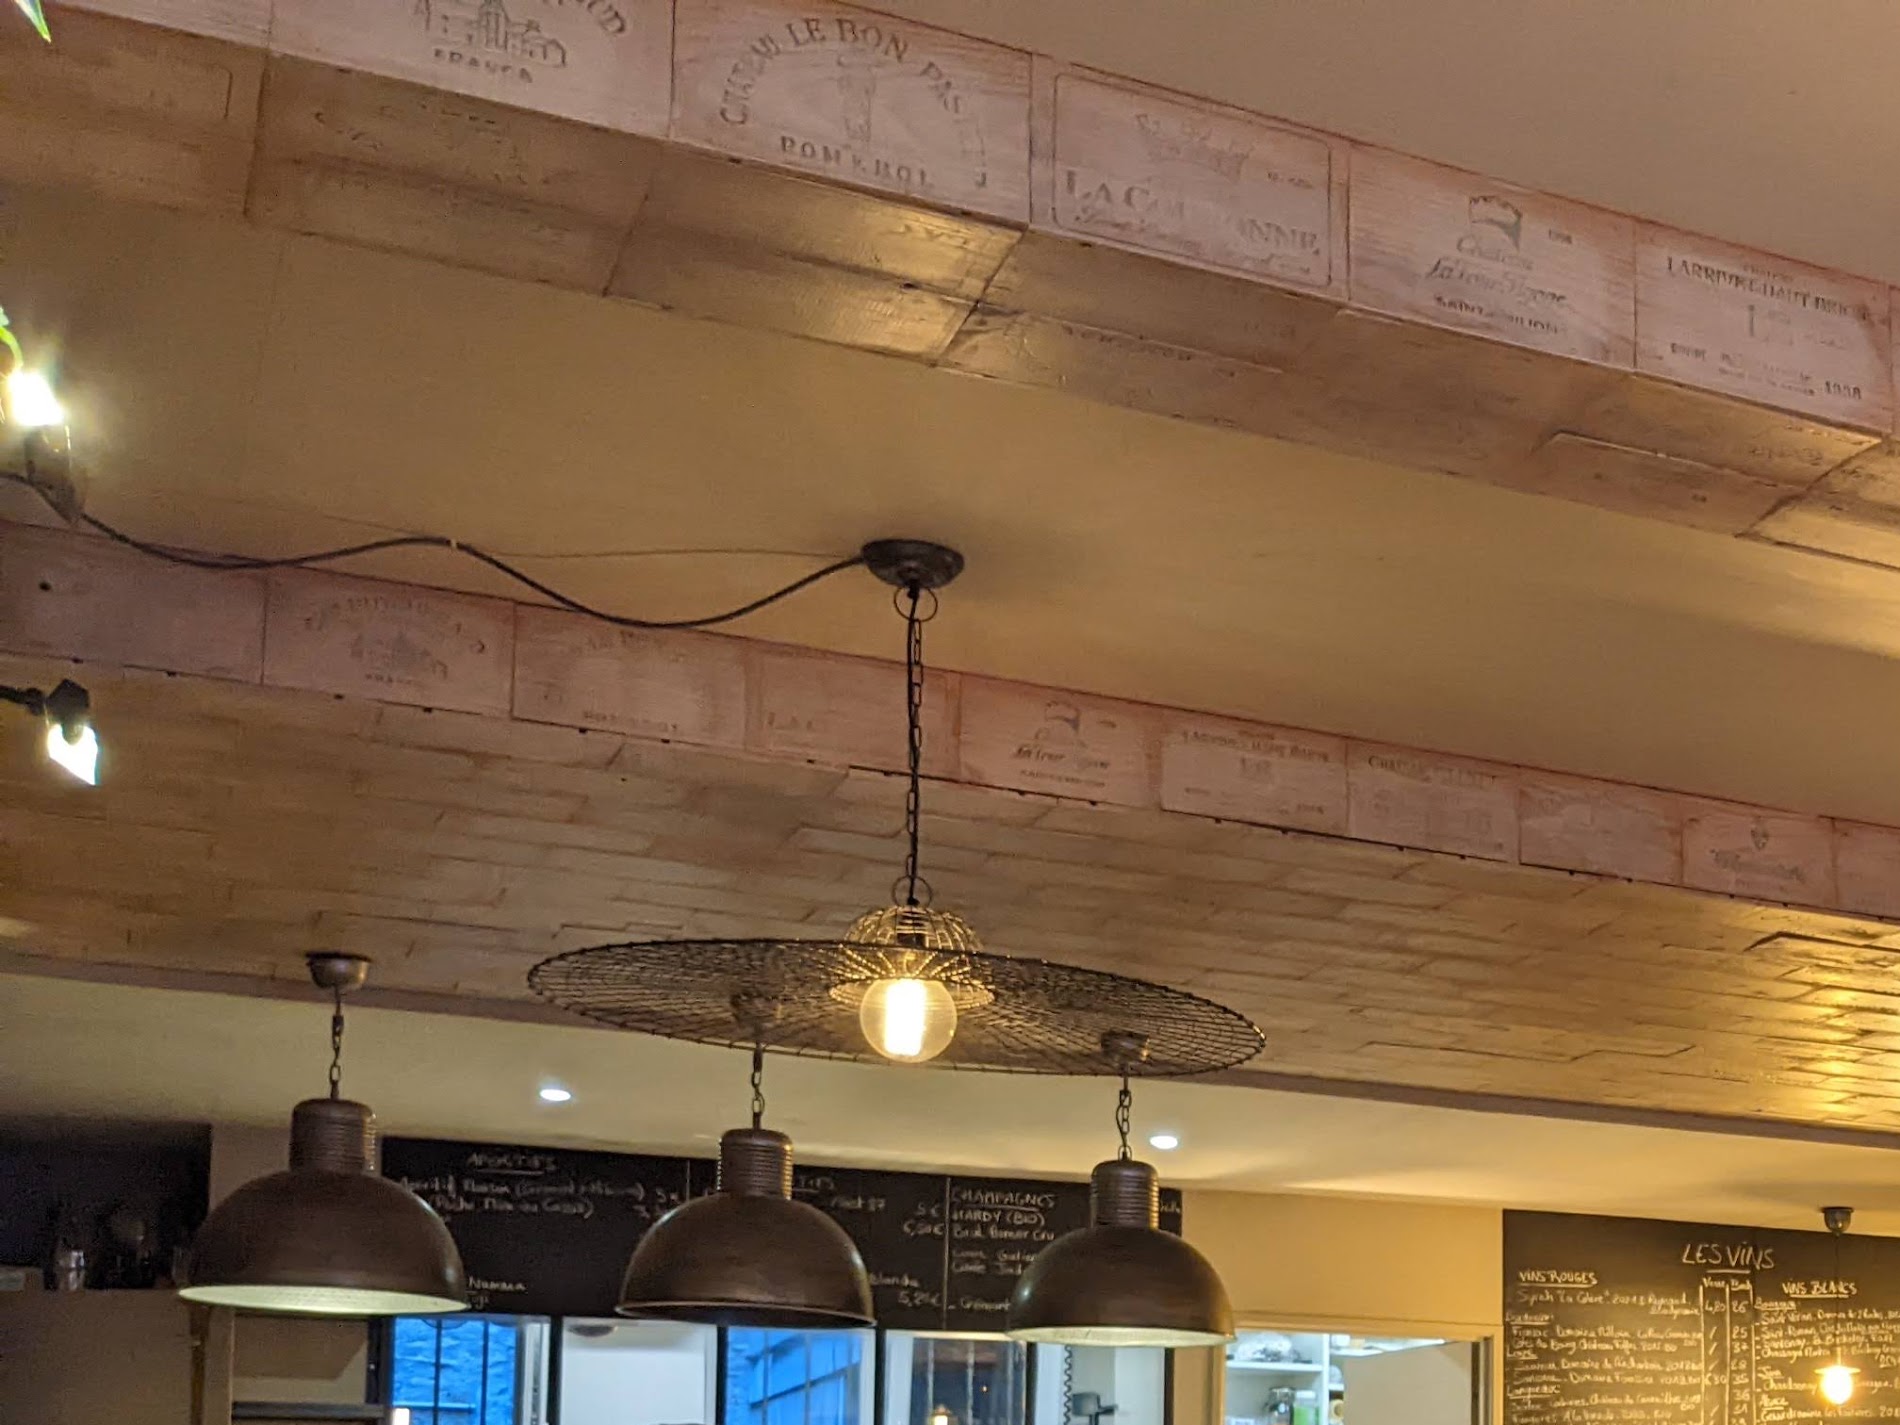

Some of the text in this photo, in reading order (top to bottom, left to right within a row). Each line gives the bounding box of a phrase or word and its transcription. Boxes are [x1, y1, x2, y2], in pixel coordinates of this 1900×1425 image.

[785, 17, 826, 47] LE
[835, 17, 907, 63] BON
[1681, 1241, 1776, 1270] LES VINS
[1519, 1268, 1598, 1285] VINS ROUGES
[1731, 1325, 1749, 1340] 25
